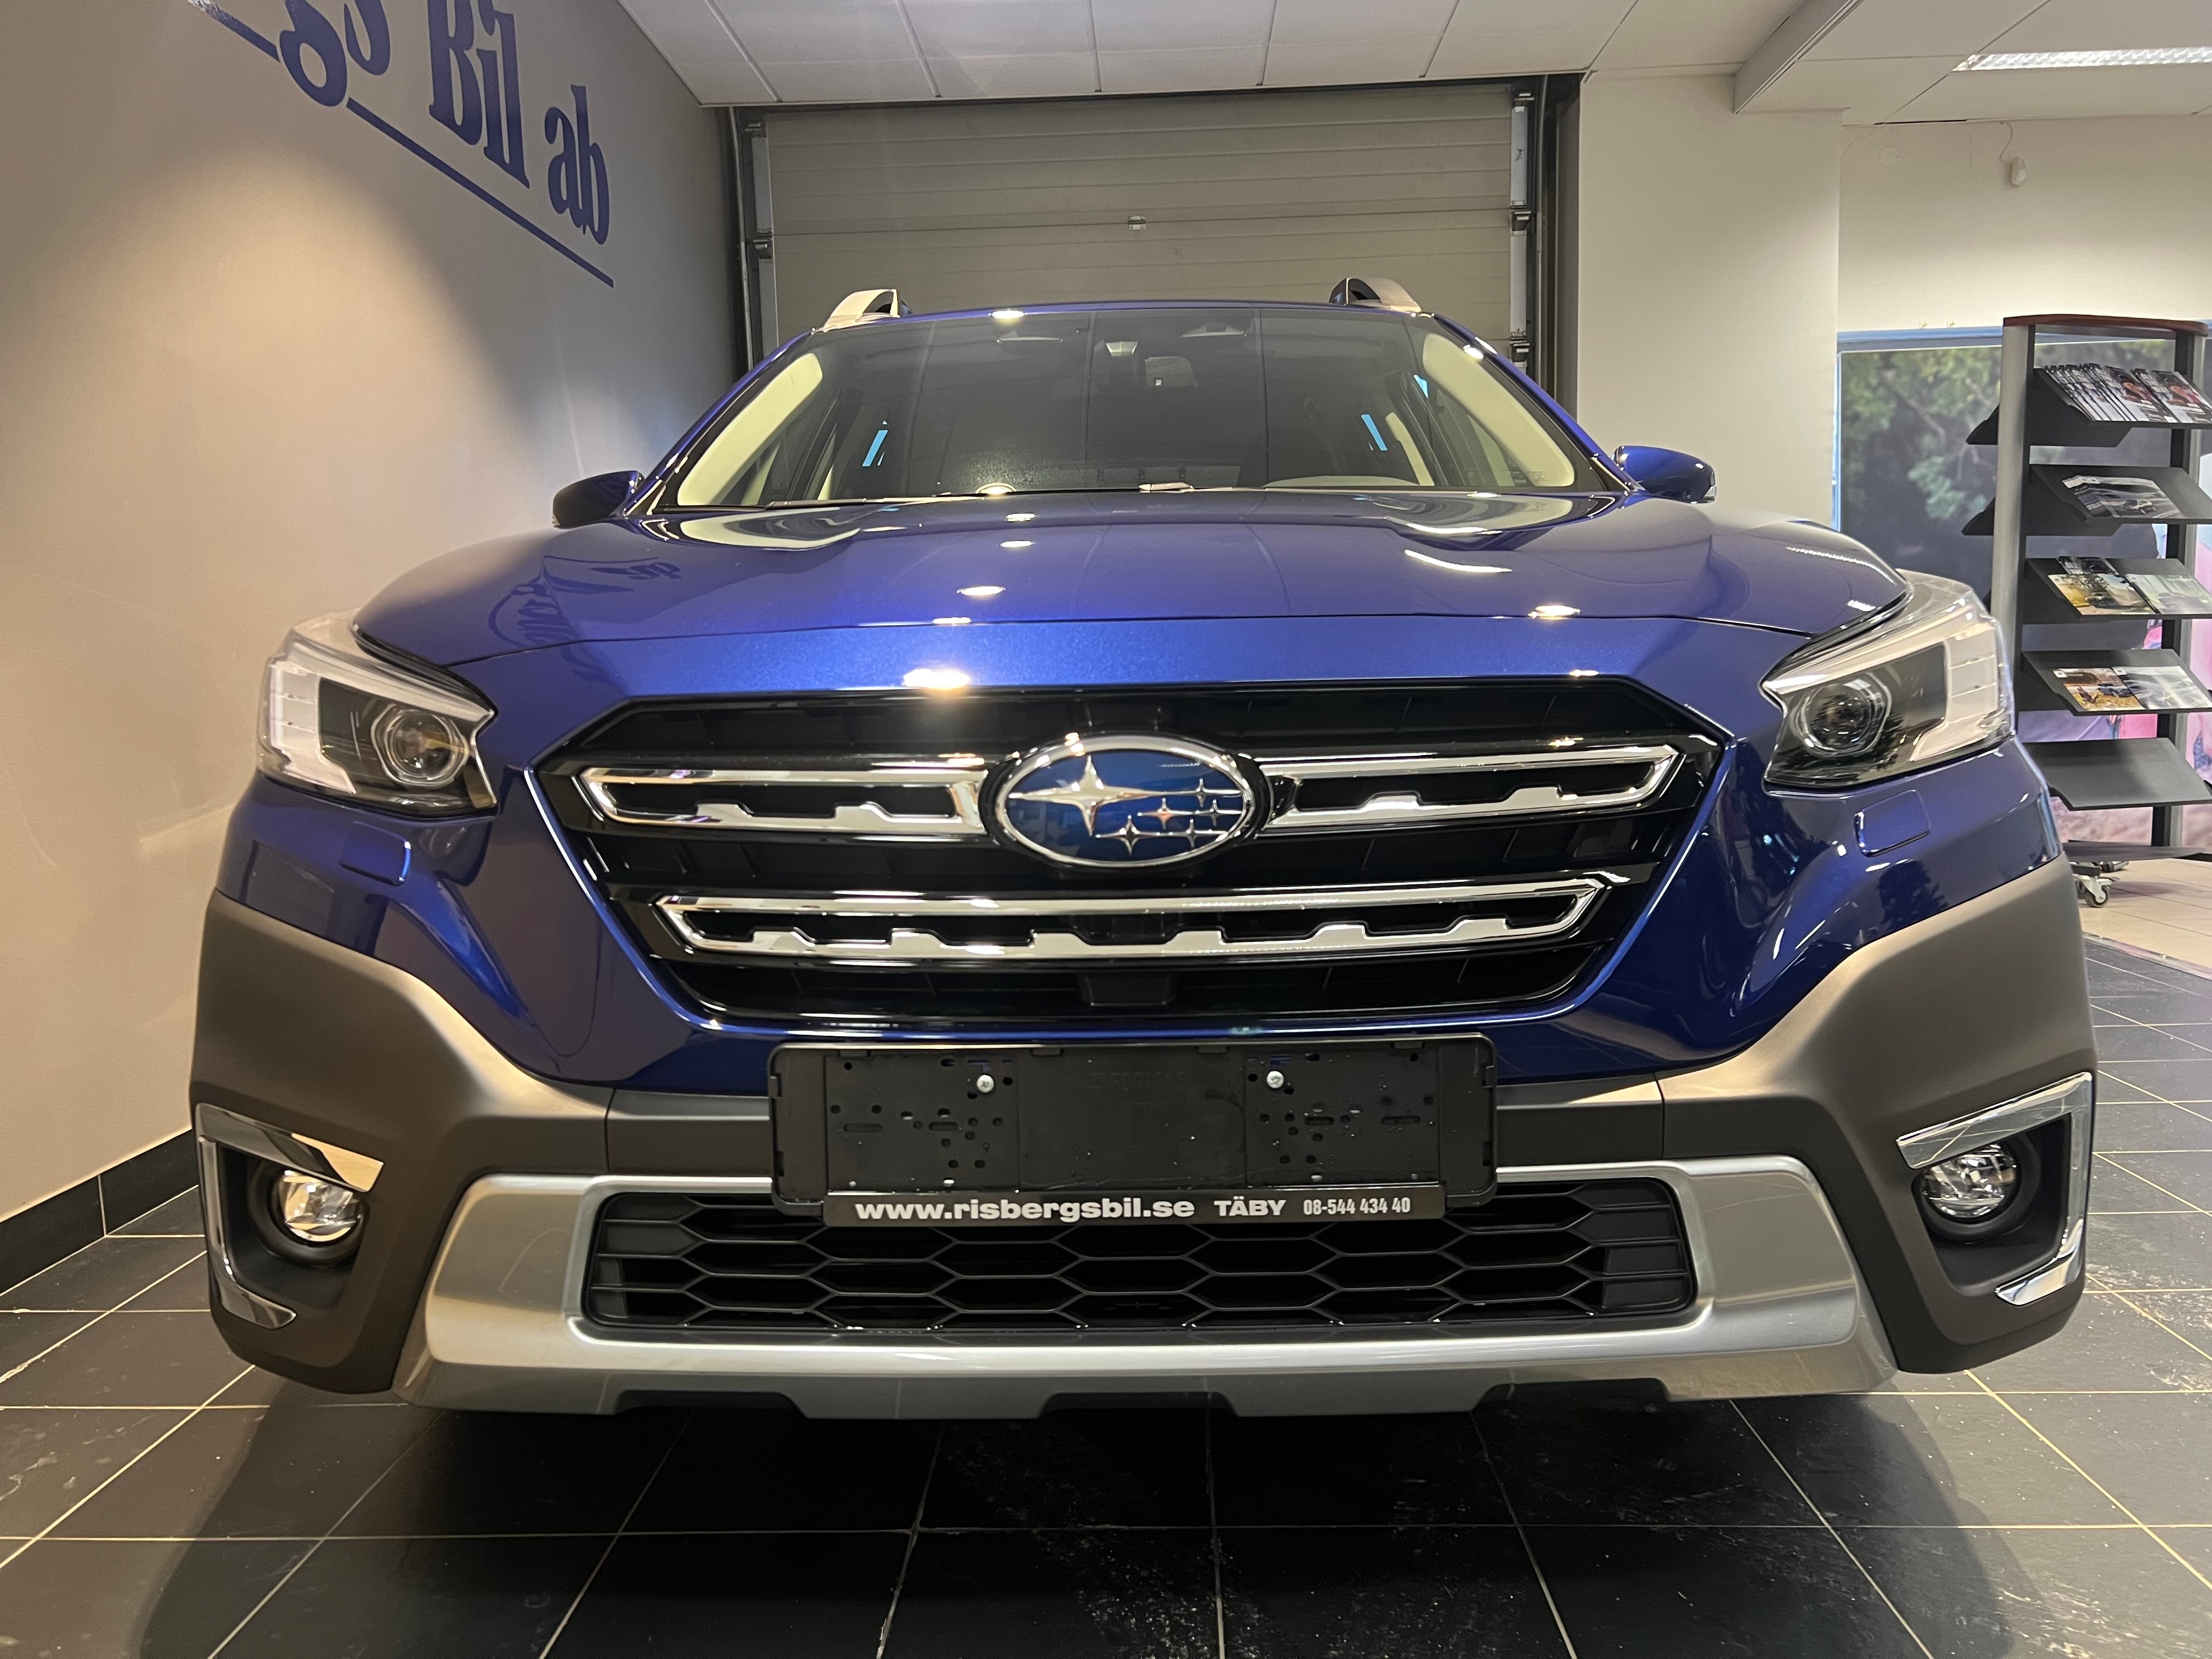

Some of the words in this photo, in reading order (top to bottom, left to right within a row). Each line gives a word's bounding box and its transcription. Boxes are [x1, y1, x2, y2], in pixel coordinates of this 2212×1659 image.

[545, 86, 610, 245] ab
[854, 1195, 1195, 1223] www.risbergsbil.se
[1213, 1195, 1287, 1217] TÄBY
[1303, 1198, 1357, 1216] 08-544
[1359, 1197, 1389, 1214] 434
[1391, 1197, 1411, 1214] 40
